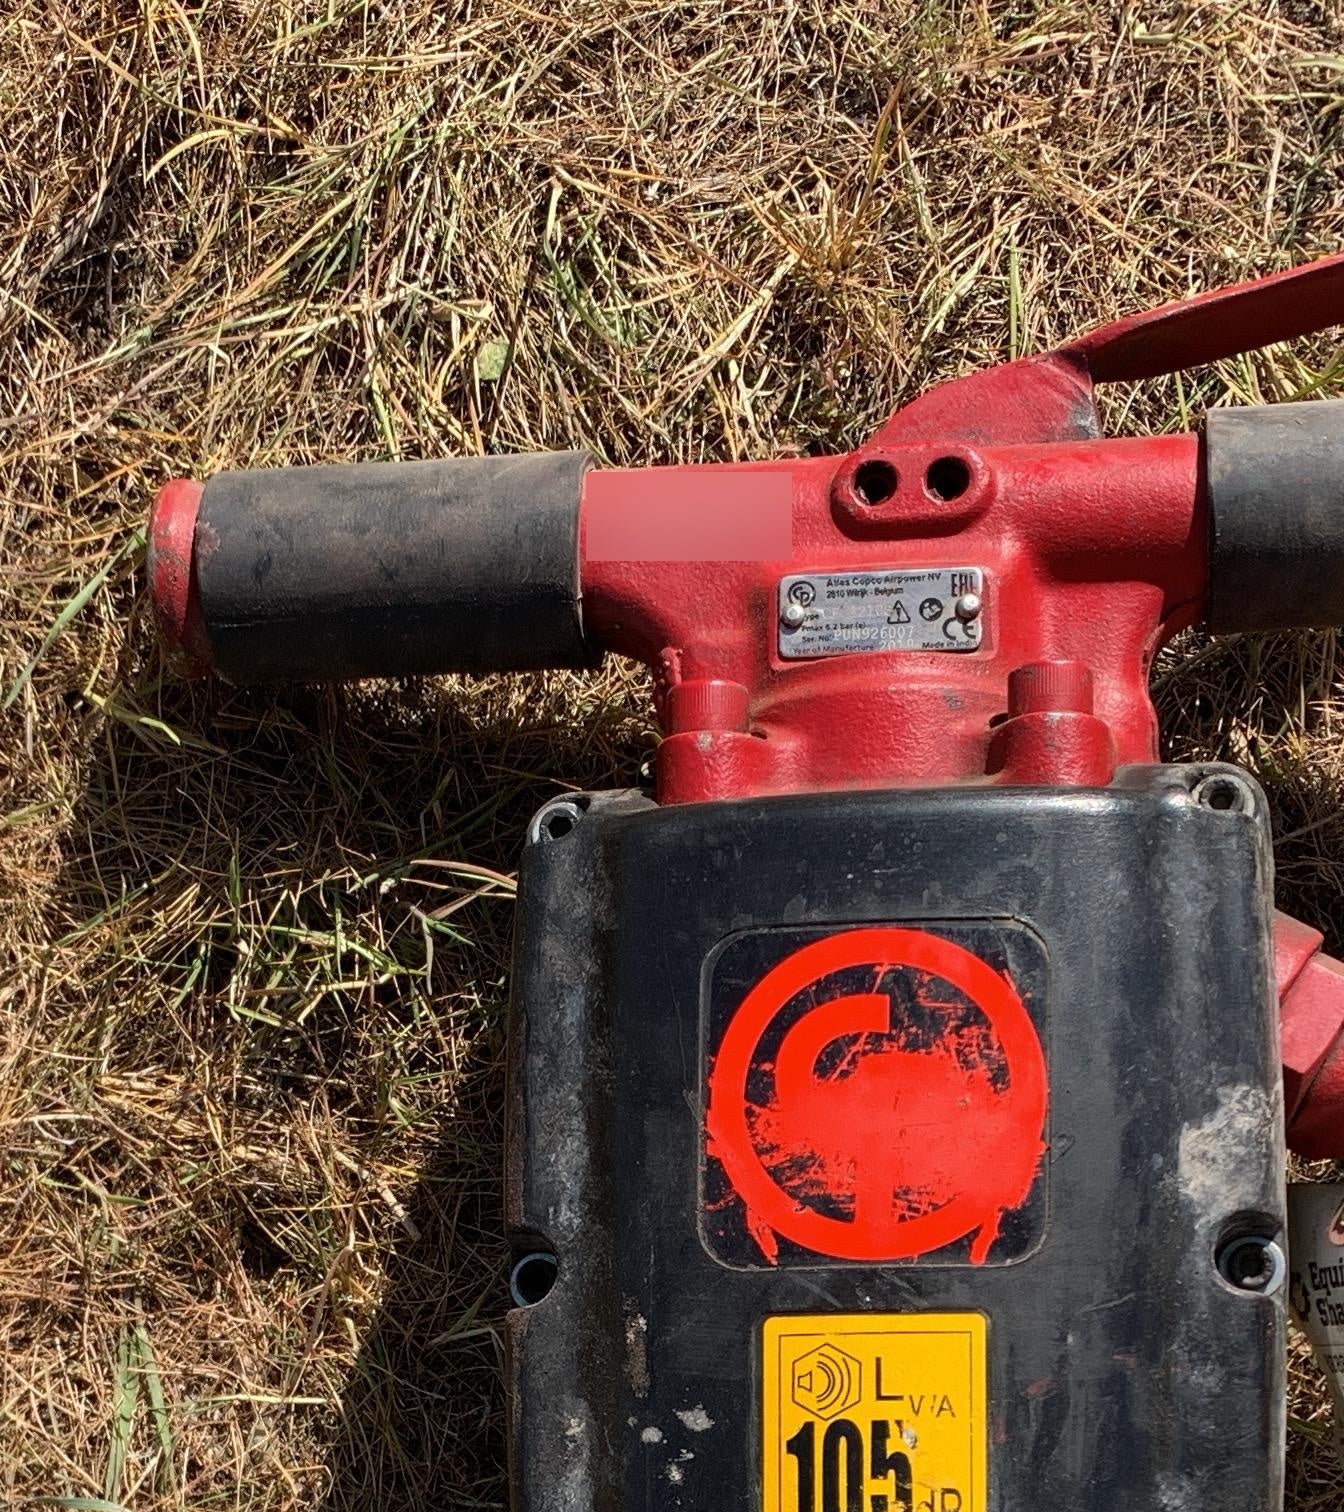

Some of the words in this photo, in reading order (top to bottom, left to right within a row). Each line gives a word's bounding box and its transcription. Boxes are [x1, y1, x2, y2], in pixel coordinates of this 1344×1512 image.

[826, 578, 850, 587] Atlas
[852, 576, 882, 587] Copco
[884, 574, 926, 584] Airpower
[927, 572, 942, 581] NV
[826, 590, 845, 599] 2610
[874, 587, 904, 597] Belgium
[823, 645, 874, 653] Manufacture
